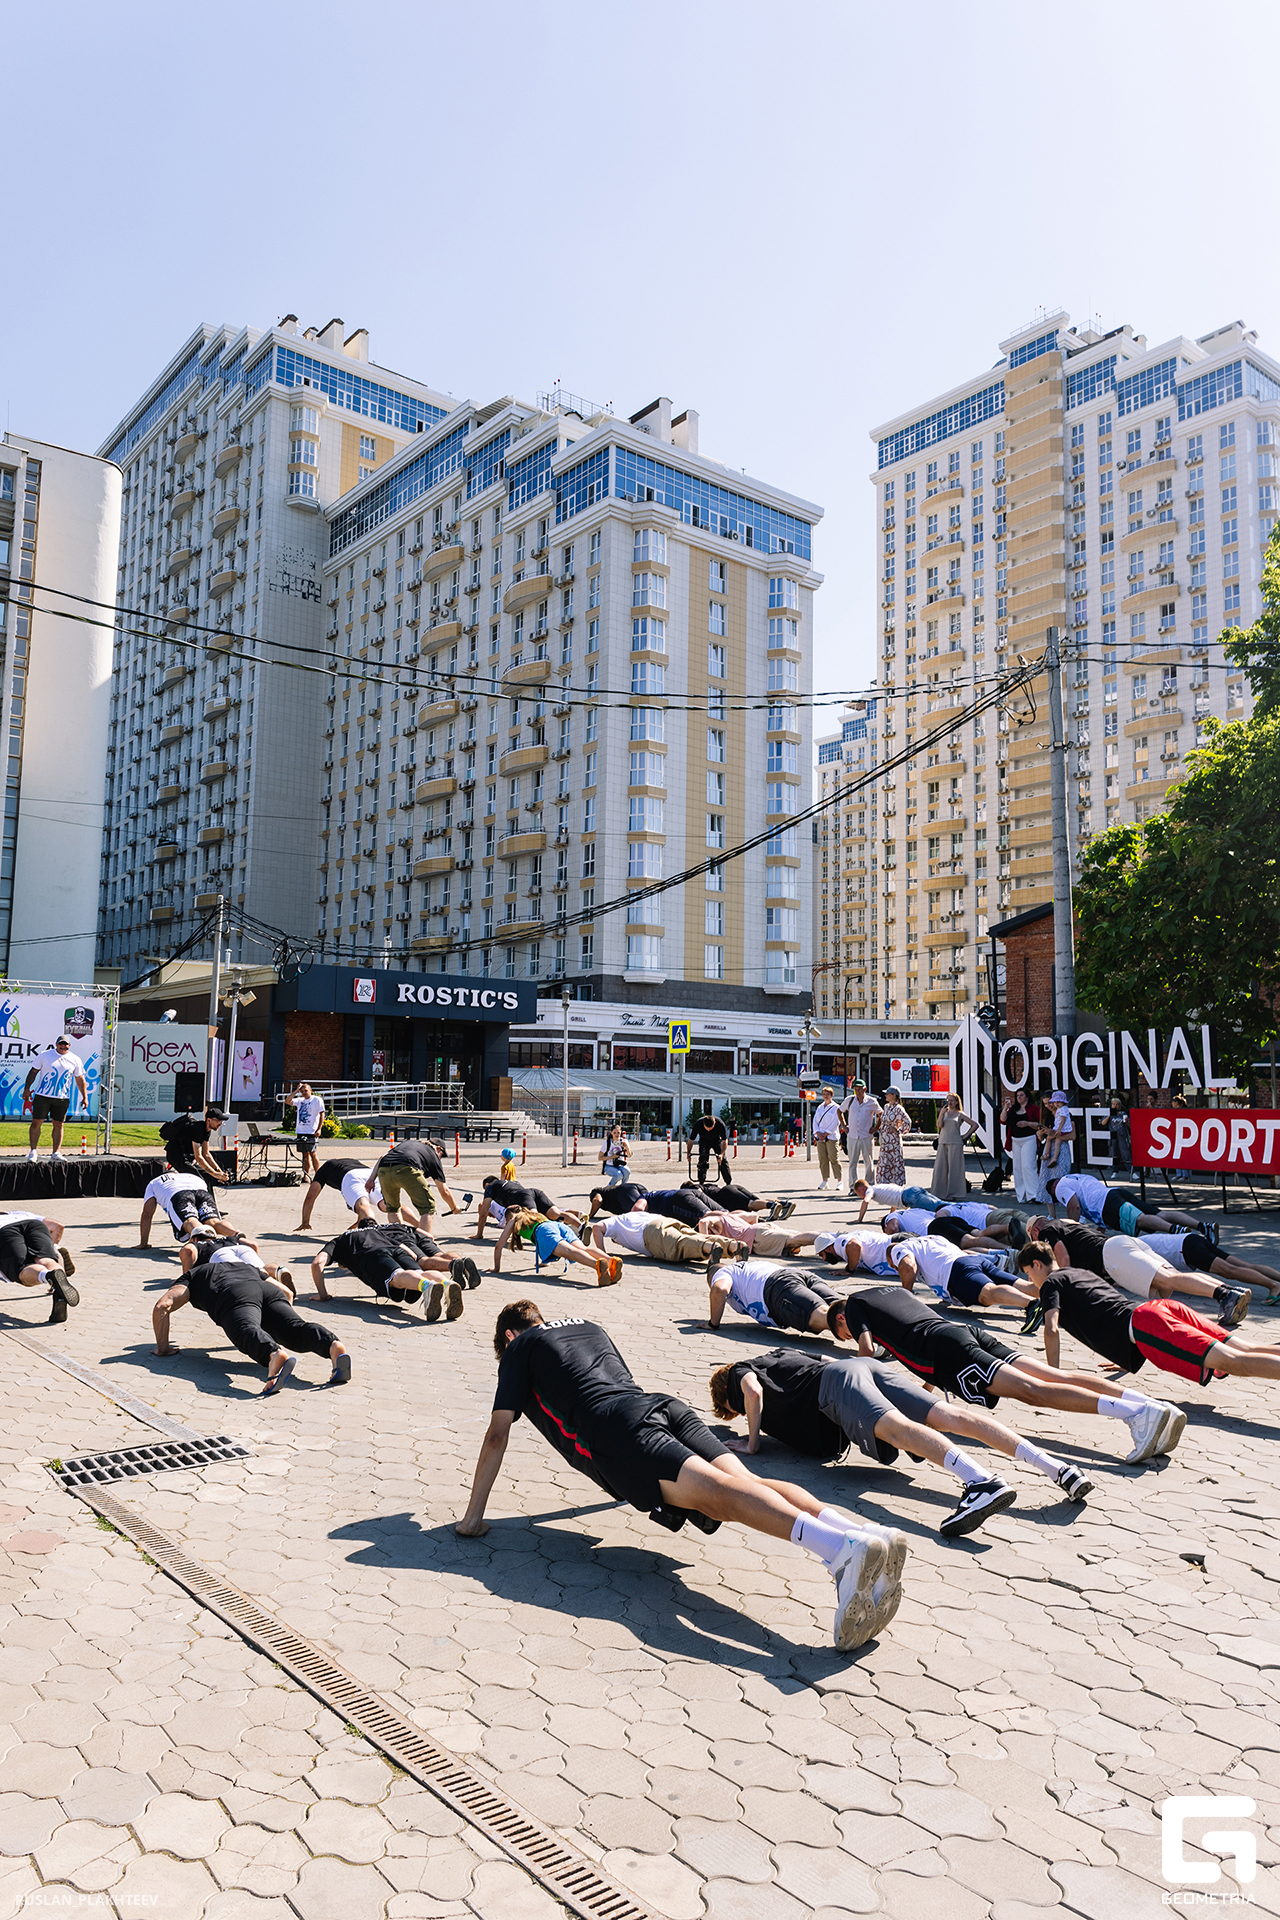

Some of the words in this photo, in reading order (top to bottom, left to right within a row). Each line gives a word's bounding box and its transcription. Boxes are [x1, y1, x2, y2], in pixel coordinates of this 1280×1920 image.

[397, 983, 519, 1010] ROSTIC'S
[768, 1027, 793, 1035] VERANDA
[880, 1031, 912, 1040] ЦЕНТР
[913, 1031, 950, 1041] ГОРОДА
[131, 1035, 197, 1062] Крем
[999, 1024, 1238, 1092] ORIGINAL
[1147, 1117, 1280, 1165] SPORT
[539, 1317, 585, 1331] LOKO
